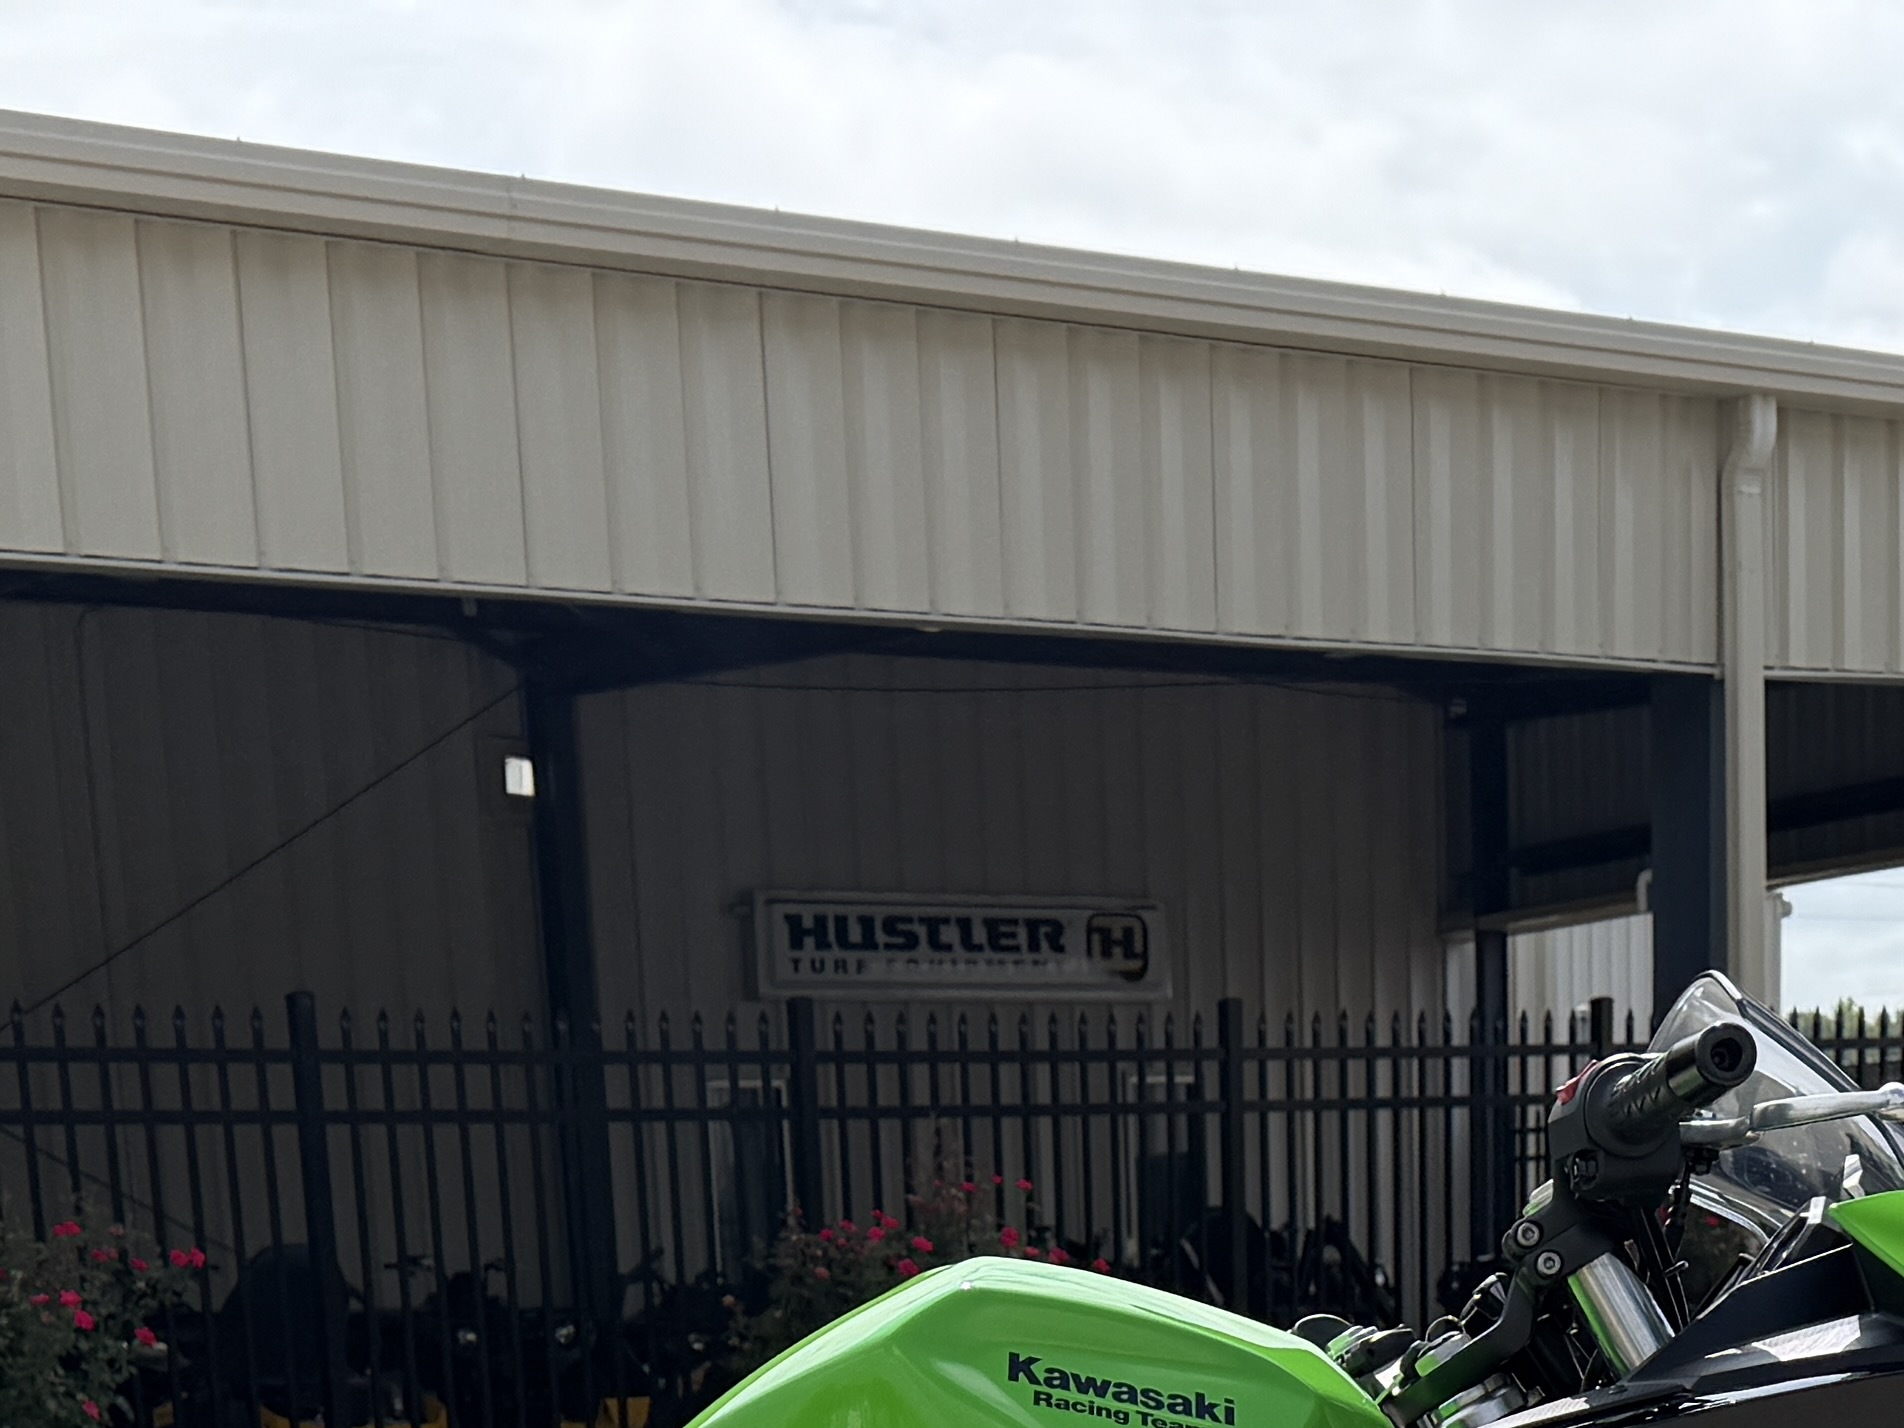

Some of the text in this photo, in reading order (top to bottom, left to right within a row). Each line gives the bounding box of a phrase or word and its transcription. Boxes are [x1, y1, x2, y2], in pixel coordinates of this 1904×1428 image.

[782, 912, 1067, 954] HUSTLER
[1007, 1351, 1236, 1427] Kawasaki
[1033, 1389, 1130, 1426] Racing
